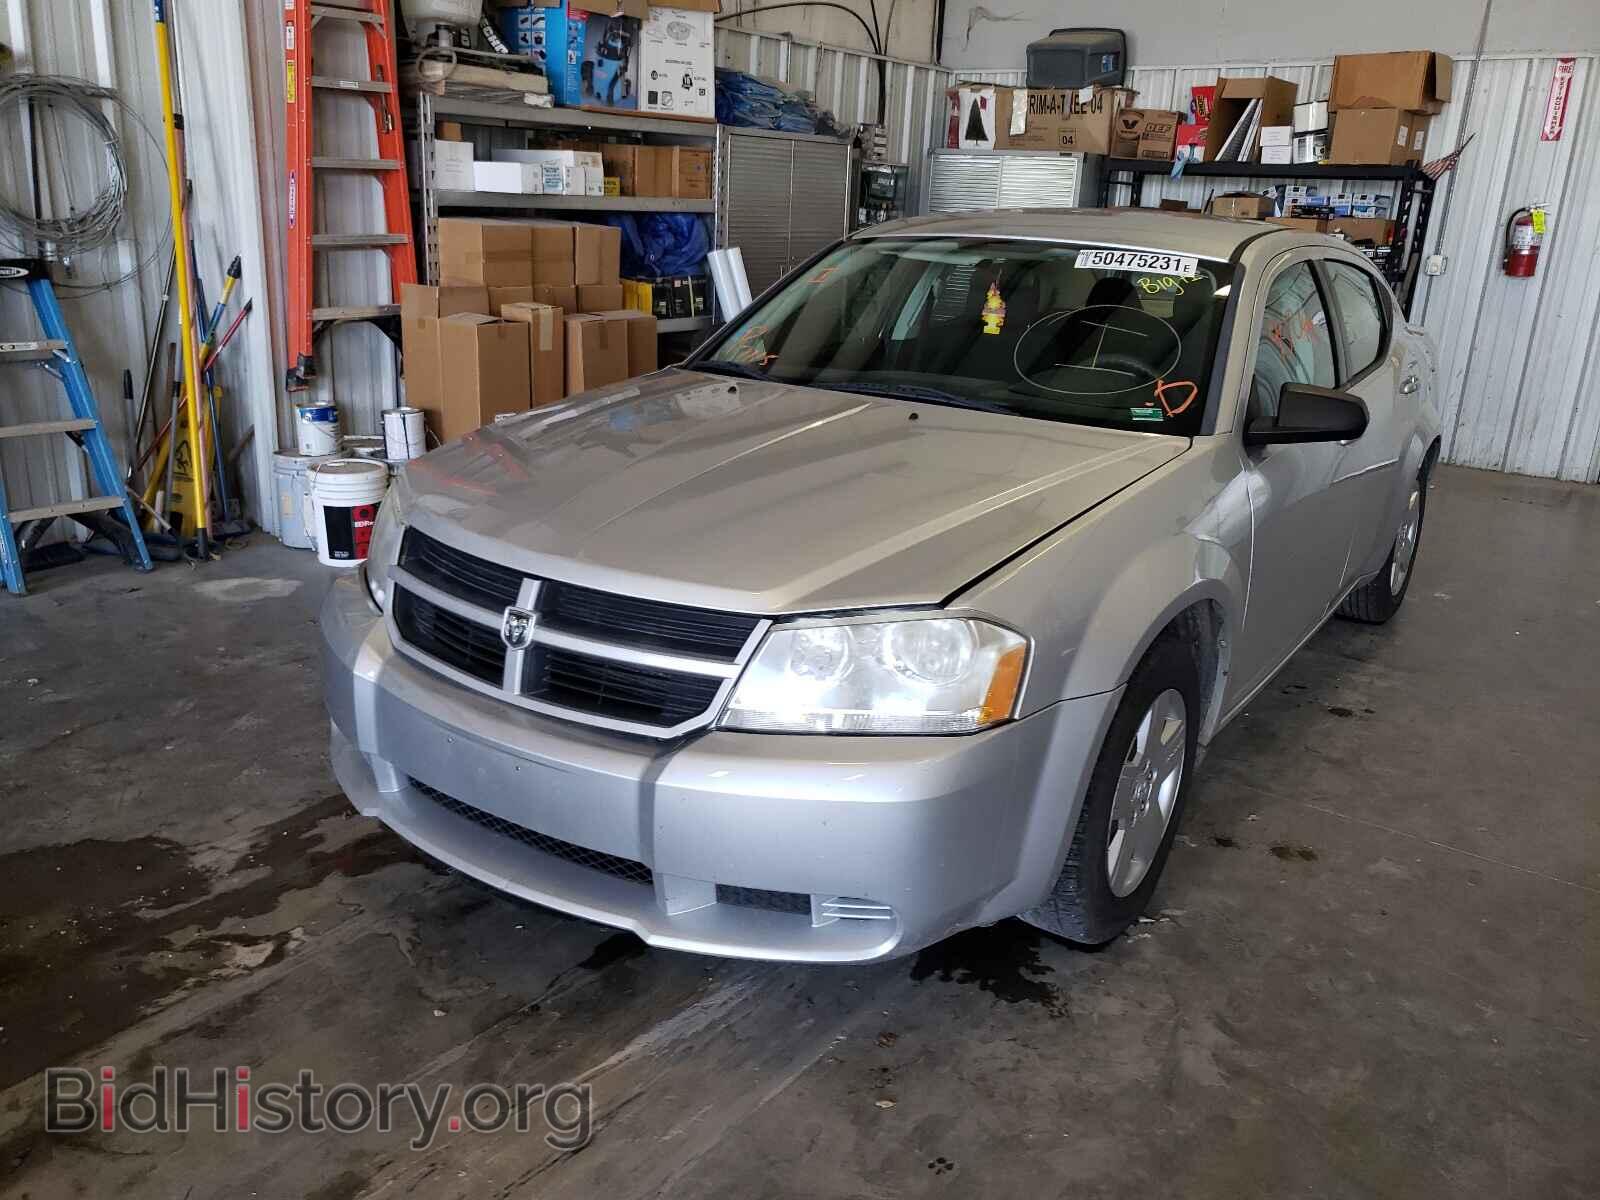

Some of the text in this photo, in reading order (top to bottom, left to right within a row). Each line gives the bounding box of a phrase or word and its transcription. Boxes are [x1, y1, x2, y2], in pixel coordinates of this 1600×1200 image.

[1559, 65, 1573, 74] FIRE
[1062, 135, 1074, 145] 04
[1091, 251, 1182, 271] 50475231
[1183, 264, 1191, 273] E
